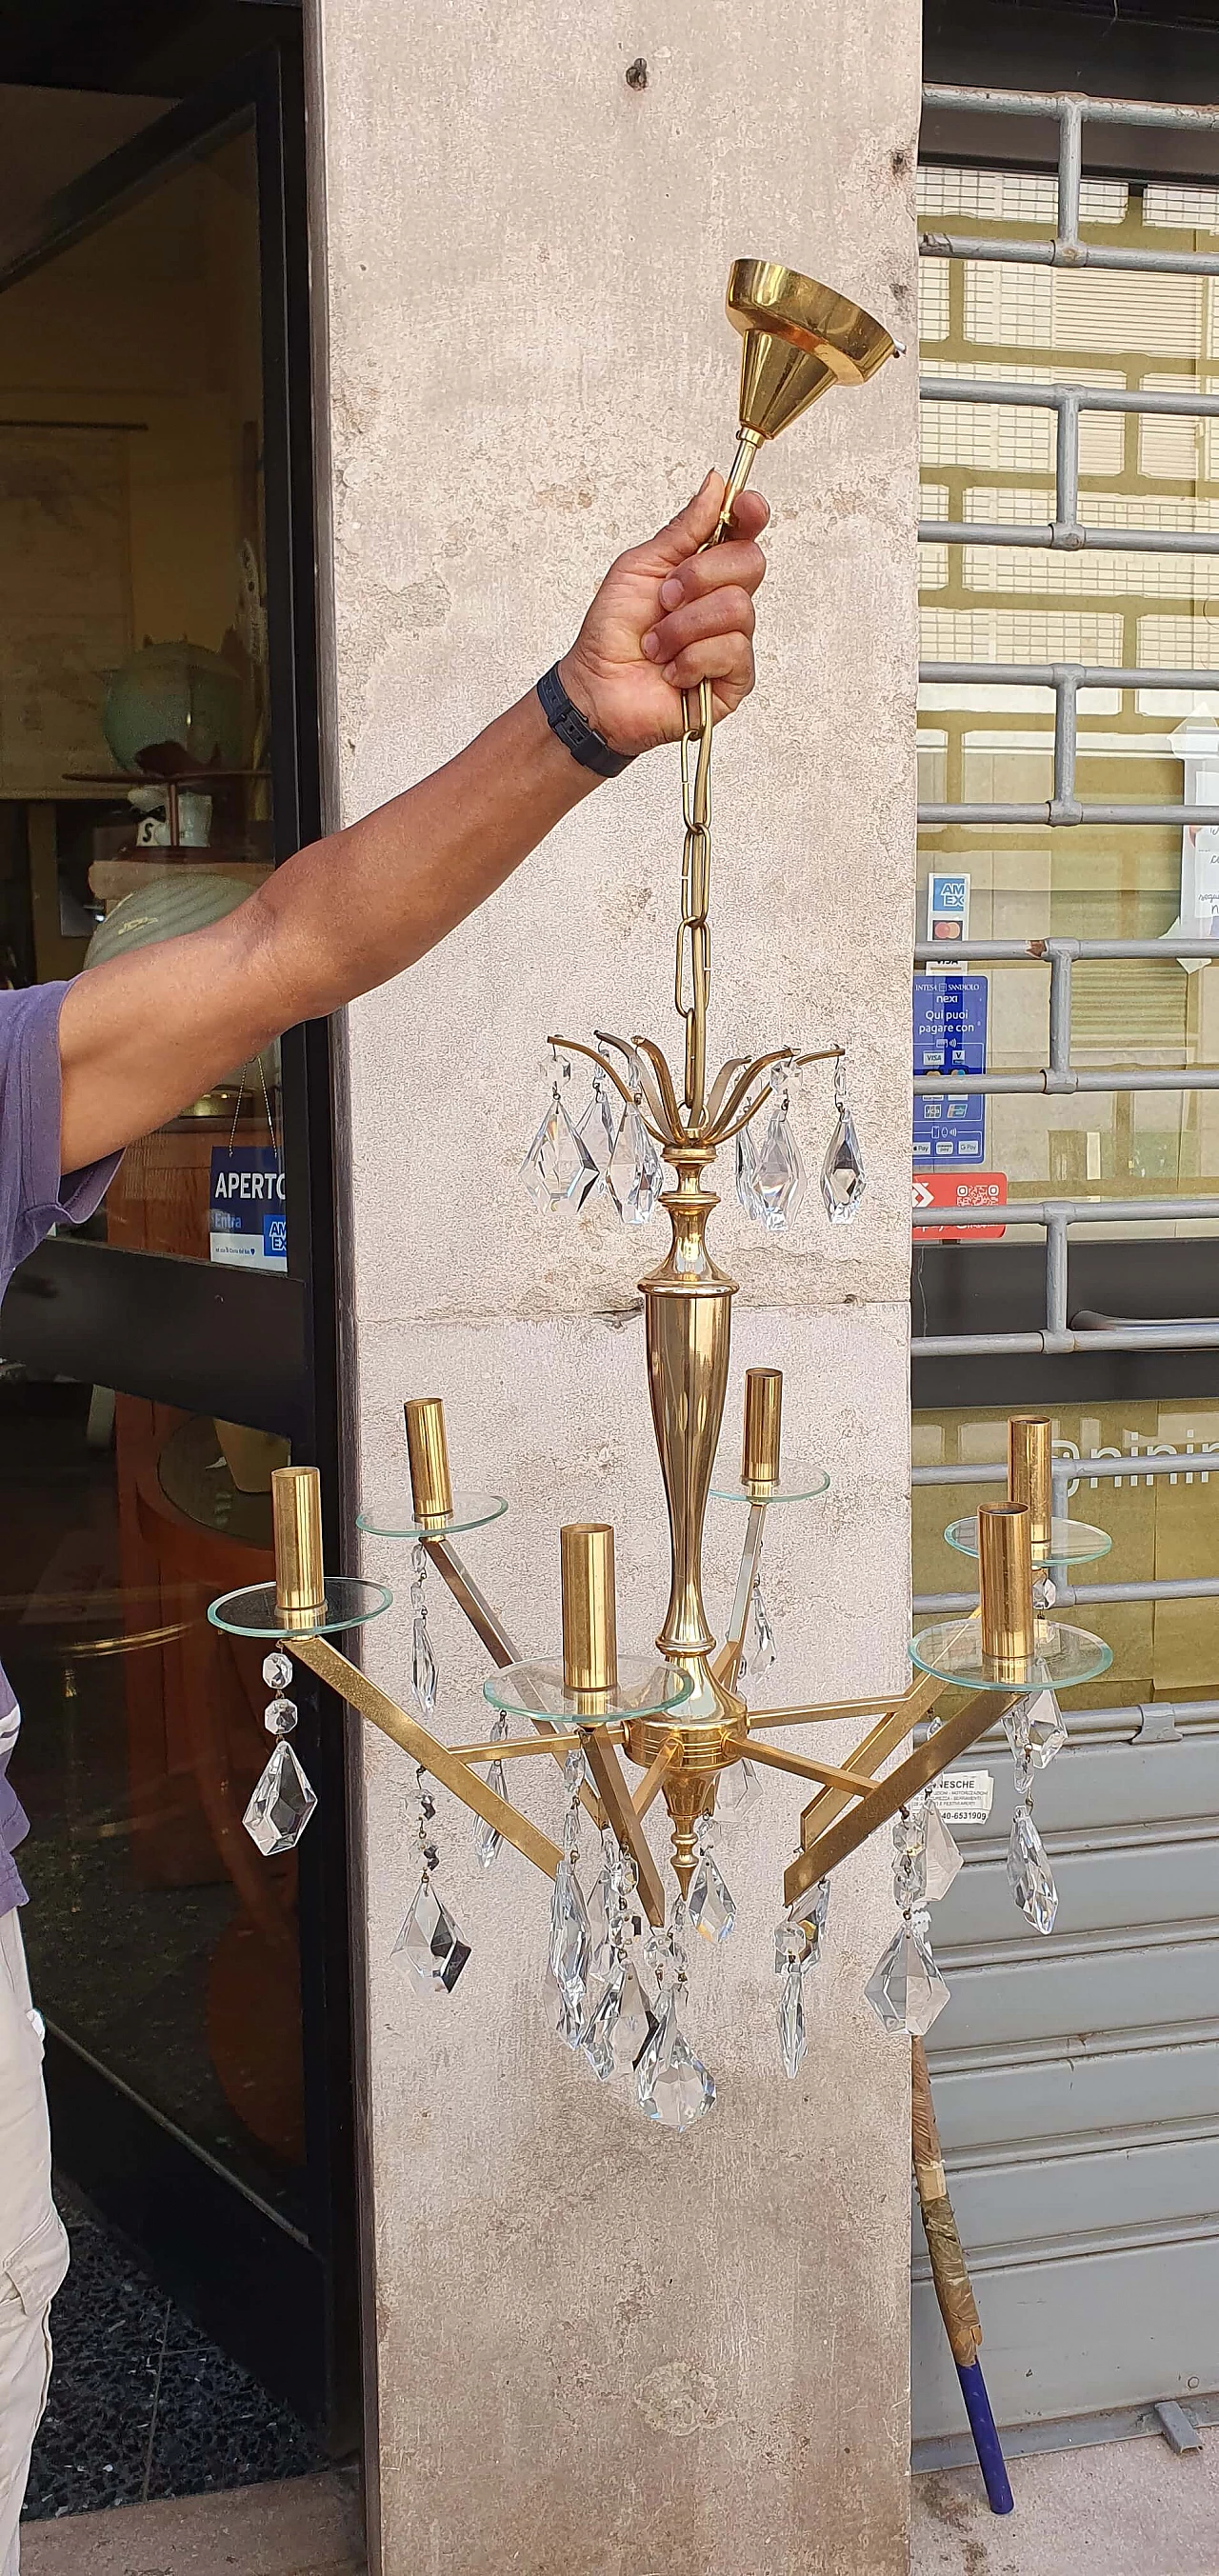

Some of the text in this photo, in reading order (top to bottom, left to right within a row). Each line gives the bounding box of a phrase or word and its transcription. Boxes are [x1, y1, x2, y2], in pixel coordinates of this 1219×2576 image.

[940, 883, 965, 896] AM
[943, 895, 965, 907] EX
[925, 1009, 969, 1022] Qui puoi
[919, 1024, 974, 1035] pagare con
[214, 1212, 242, 1228] Entra
